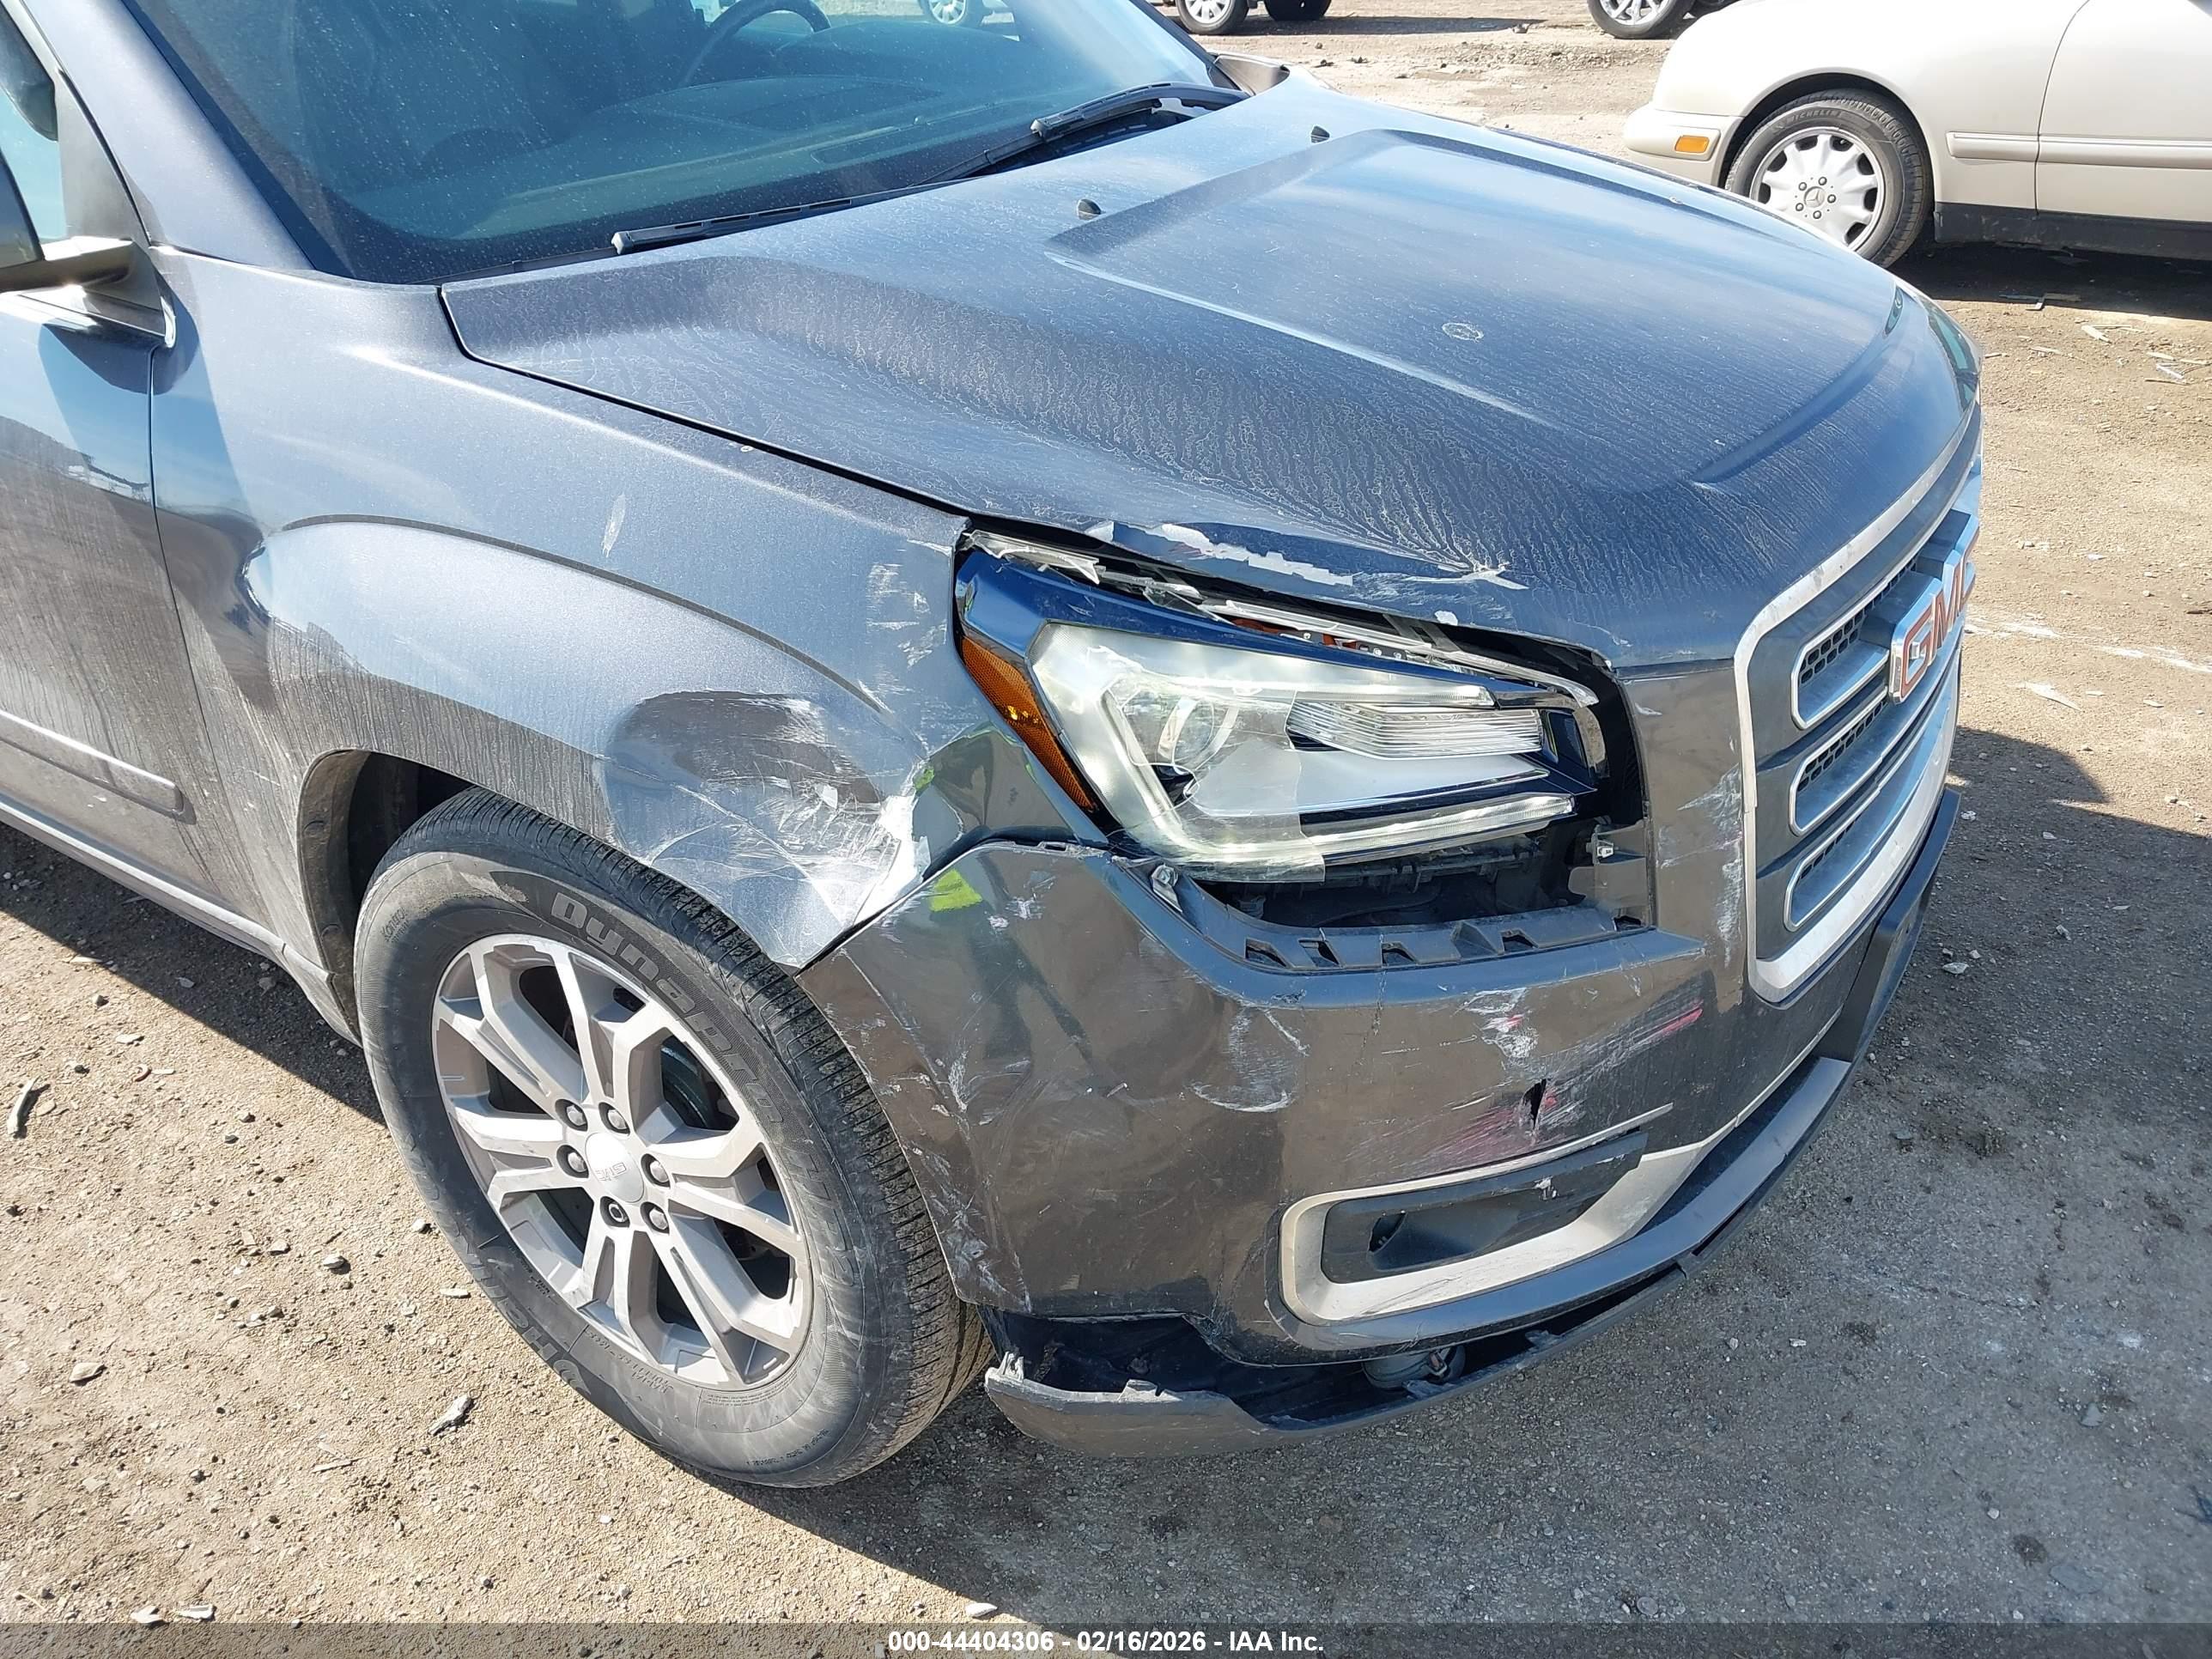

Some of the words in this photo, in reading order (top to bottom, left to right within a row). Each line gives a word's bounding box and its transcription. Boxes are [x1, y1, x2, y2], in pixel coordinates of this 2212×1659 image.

[1787, 109, 1841, 123] MICHELIN
[1889, 514, 1980, 705] GMC
[550, 891, 782, 1123] Dynapro
